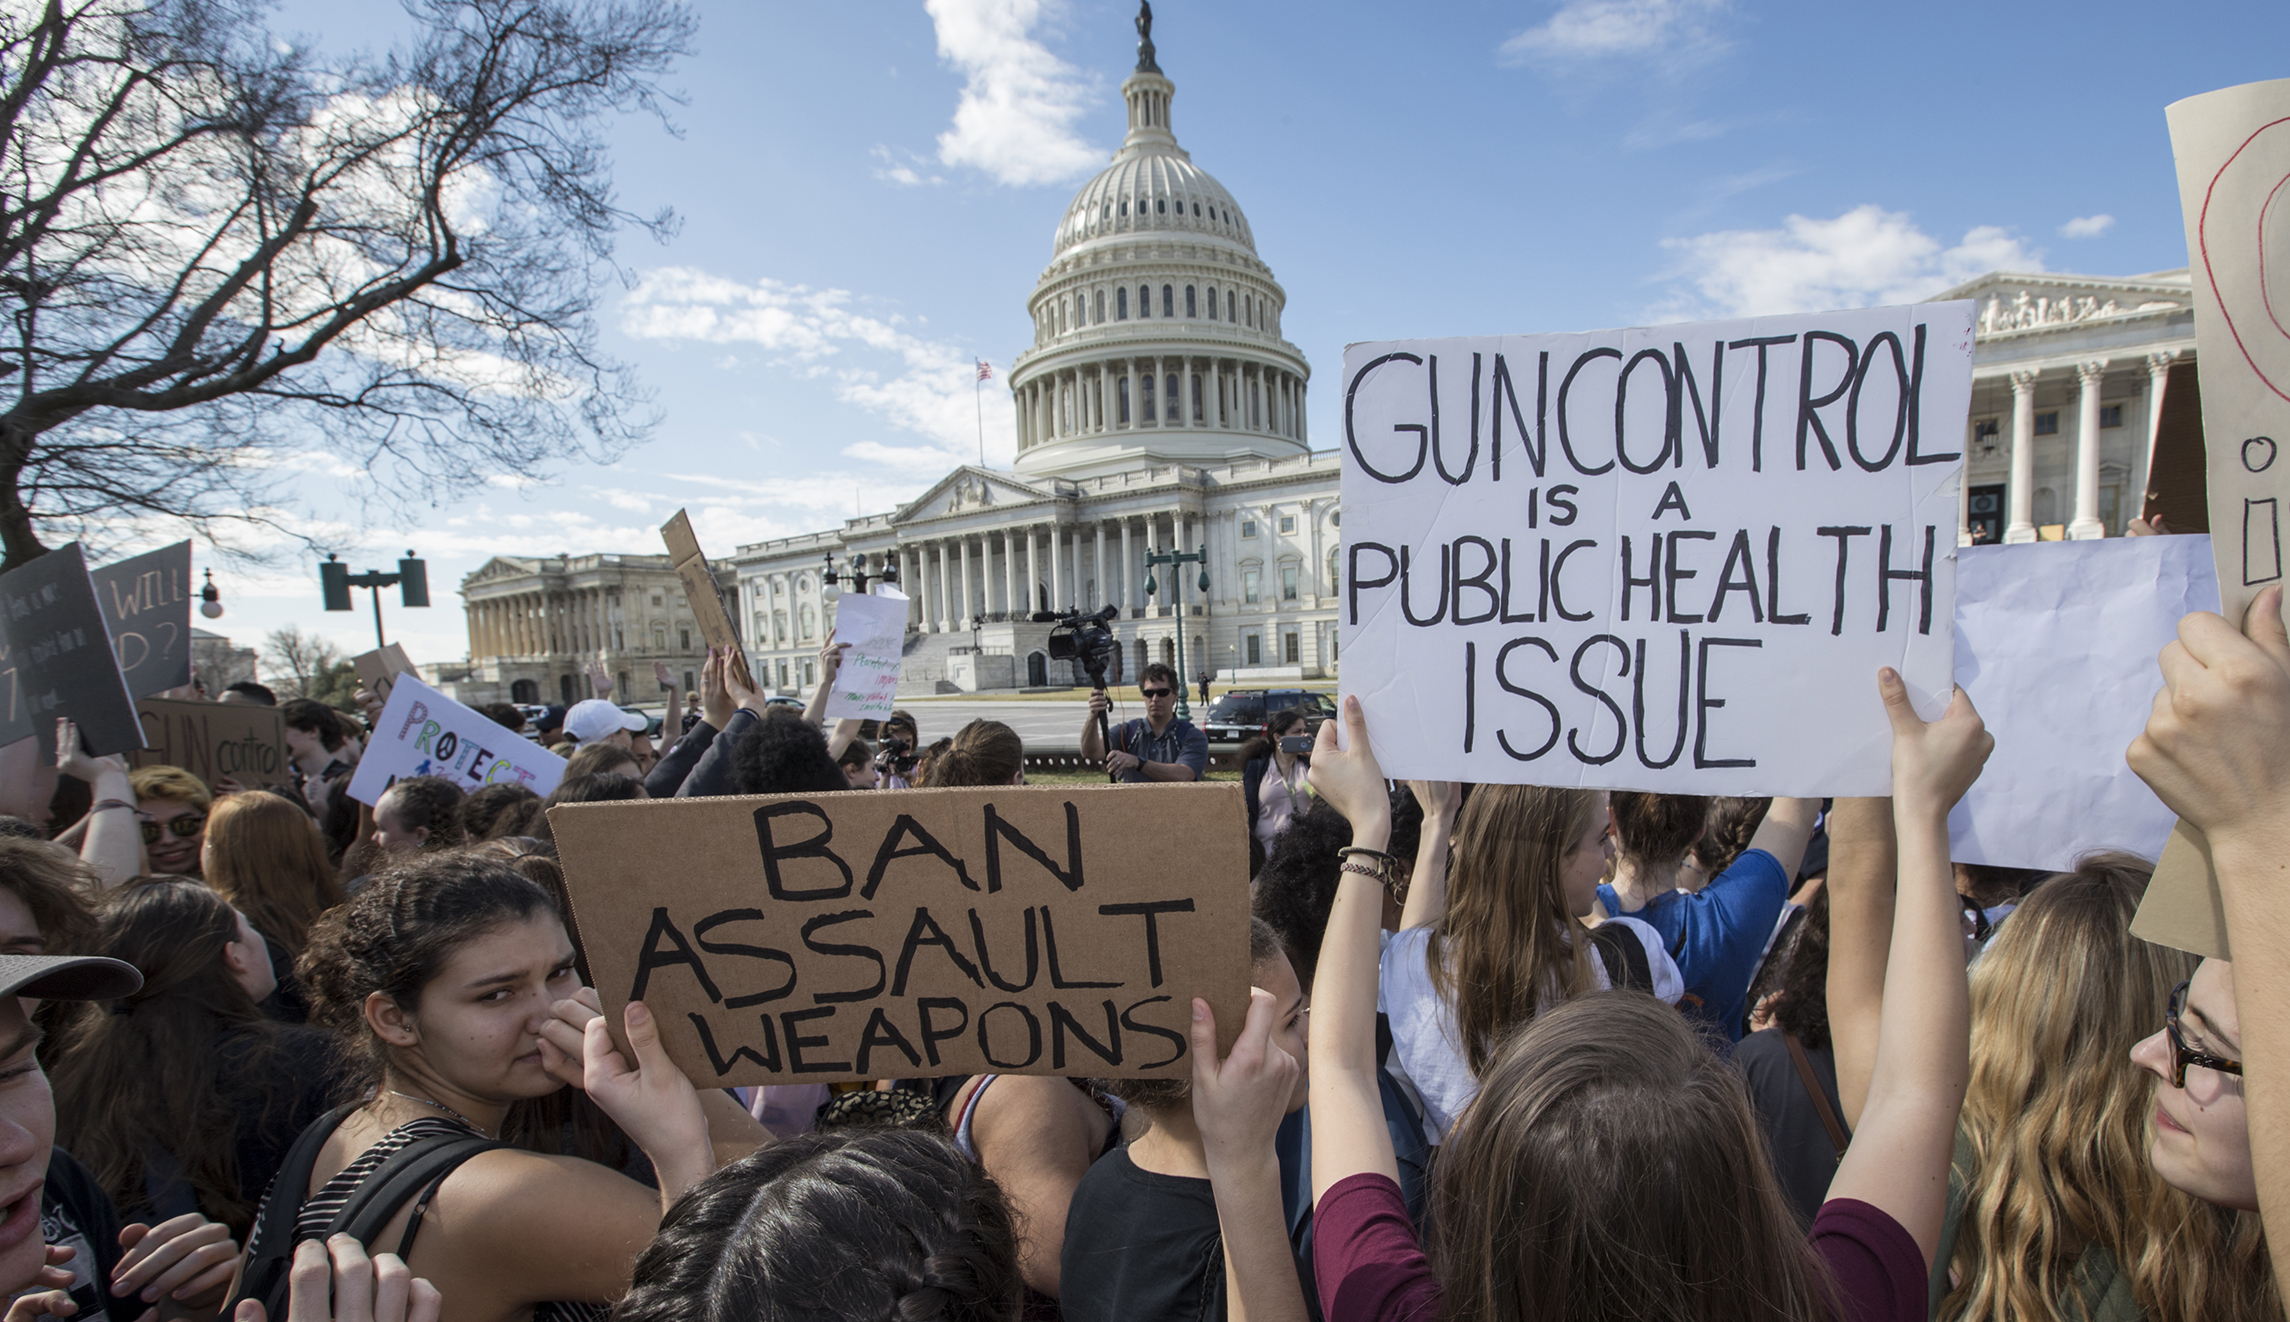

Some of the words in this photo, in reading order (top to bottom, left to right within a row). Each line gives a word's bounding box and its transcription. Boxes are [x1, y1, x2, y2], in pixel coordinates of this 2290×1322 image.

[1527, 483, 1580, 528] IS
[1651, 480, 1691, 520] A
[110, 568, 183, 620] WILL
[1349, 533, 1599, 627] PUBLIC
[1620, 523, 1937, 636] HEALTH
[1464, 628, 1763, 769] ISSUE
[217, 715, 283, 775] control
[398, 700, 536, 785] PROTECT
[753, 800, 1084, 901] BAN
[629, 898, 1196, 1009] ASSAULT
[687, 994, 1189, 1076] WEAPONS
